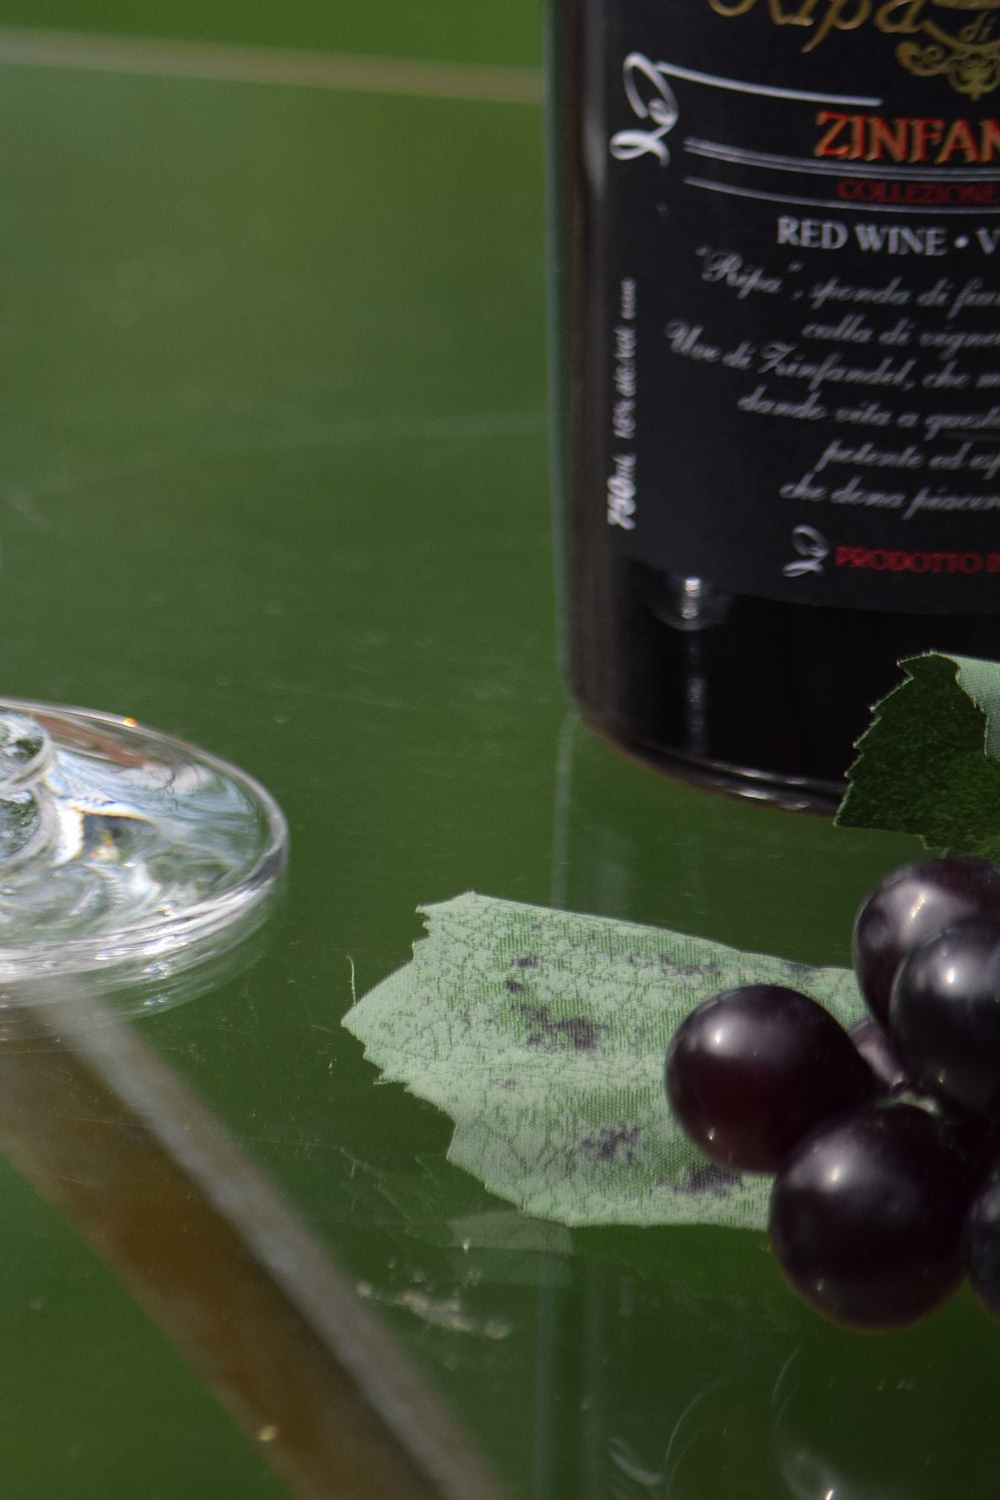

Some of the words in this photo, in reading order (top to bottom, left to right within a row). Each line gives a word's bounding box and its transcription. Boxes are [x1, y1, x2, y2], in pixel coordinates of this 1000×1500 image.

[776, 214, 849, 250] RED
[854, 222, 949, 256] WINE
[917, 276, 954, 307] di
[878, 315, 917, 345] di
[722, 340, 757, 369] di
[757, 340, 917, 392] Zinfandel,
[921, 358, 969, 389] che
[835, 401, 893, 426] vita
[897, 411, 921, 428] a
[928, 440, 974, 470] ed
[779, 471, 828, 500] che
[834, 545, 985, 574] PRODOTTO
